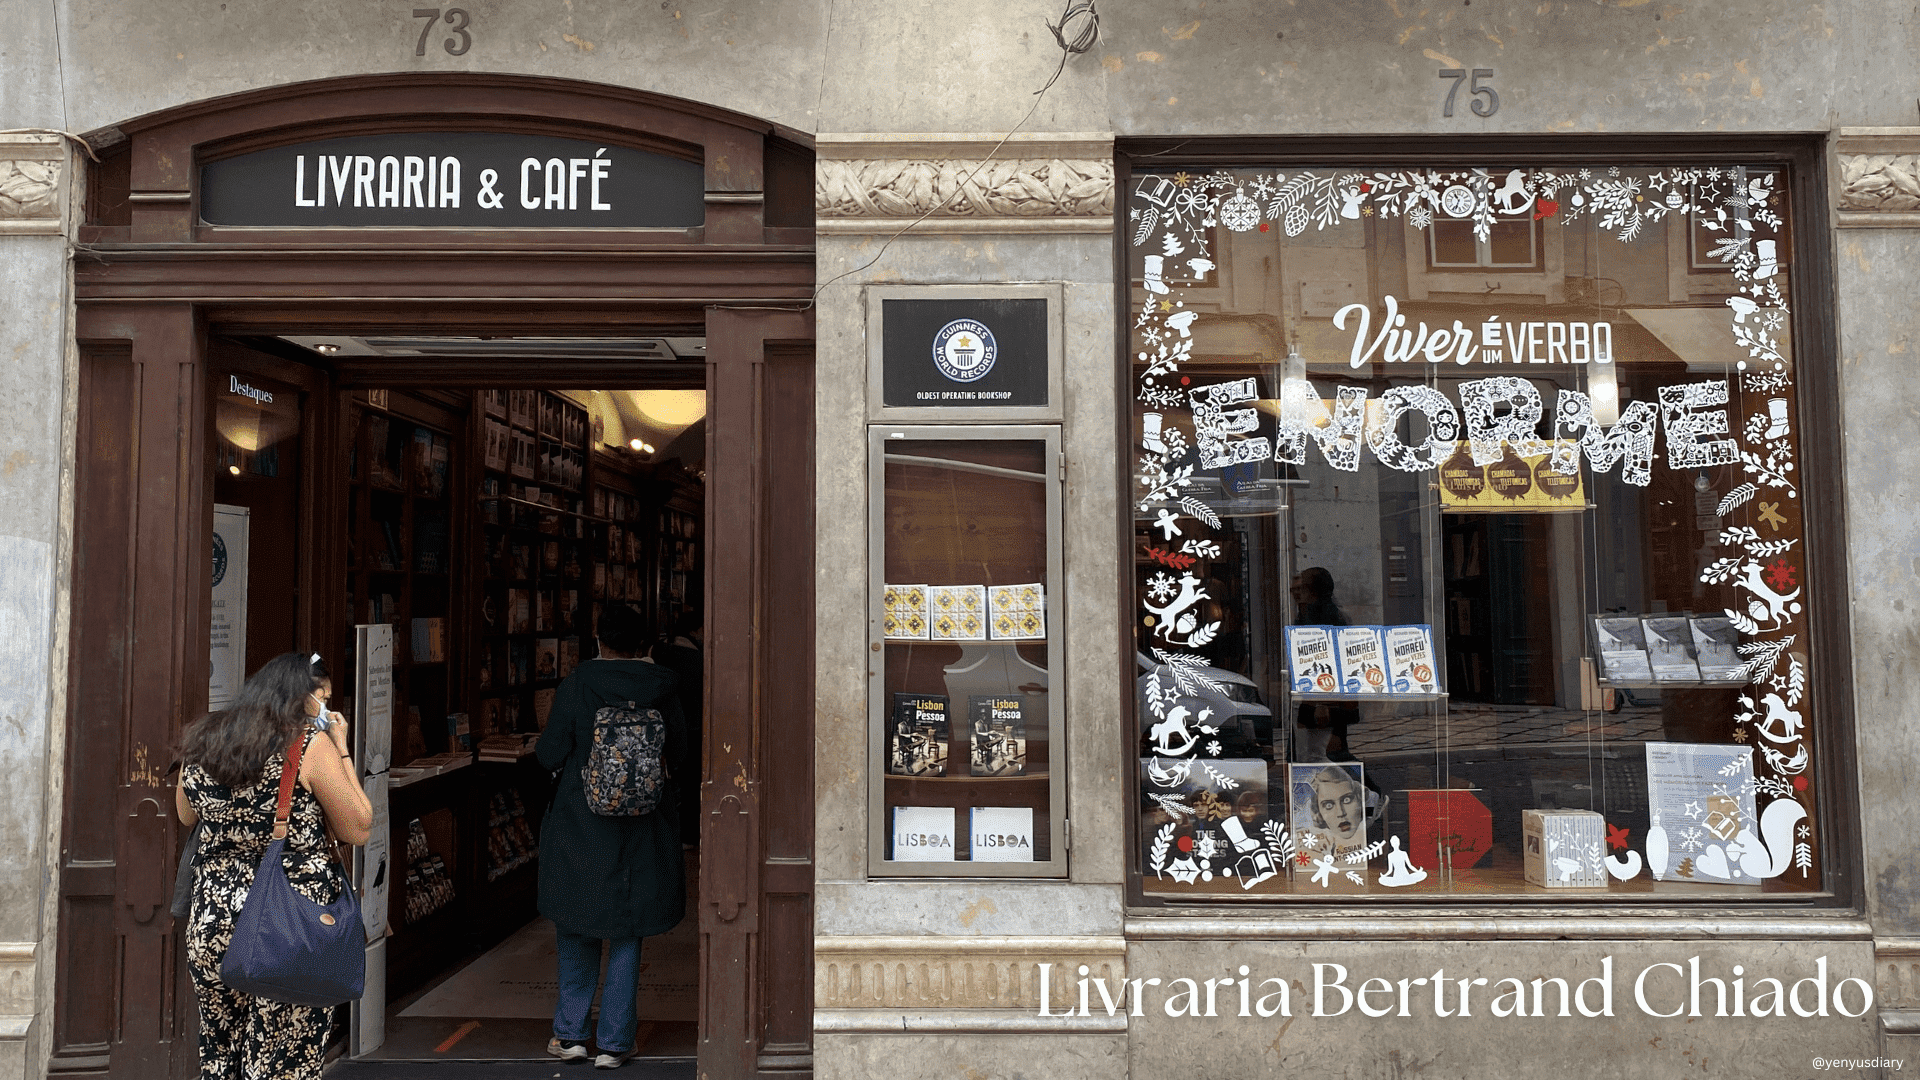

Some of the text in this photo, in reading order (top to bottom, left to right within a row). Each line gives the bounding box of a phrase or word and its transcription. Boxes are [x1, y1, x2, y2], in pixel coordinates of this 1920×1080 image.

[413, 8, 471, 56] 73
[1439, 69, 1499, 117] 75
[295, 147, 612, 211] LIVRARIA & CAFÉ
[941, 322, 989, 340] GUINNESS
[1333, 295, 1613, 369] Viver É UM VERBO
[936, 346, 994, 379] WORLD RECORDS
[229, 374, 273, 405] Destaques
[917, 391, 1012, 400] OLDEST OPERATING BOOKSHOP
[1188, 376, 1742, 486] ENORME
[1297, 640, 1327, 657] MORREU
[1313, 651, 1328, 661] VEZES
[1345, 640, 1376, 658] MORREU
[1361, 651, 1377, 661] VEZES
[1394, 640, 1424, 658] MORREU
[1410, 651, 1426, 661] VEZES
[916, 699, 944, 711] Lisbon
[991, 699, 1019, 709] Lisboa
[916, 710, 945, 721] Pessoa
[991, 709, 1021, 719] Pessoa
[898, 833, 951, 848] LISBOA
[976, 833, 1029, 848] LISBOA
[1195, 830, 1216, 840] THE
